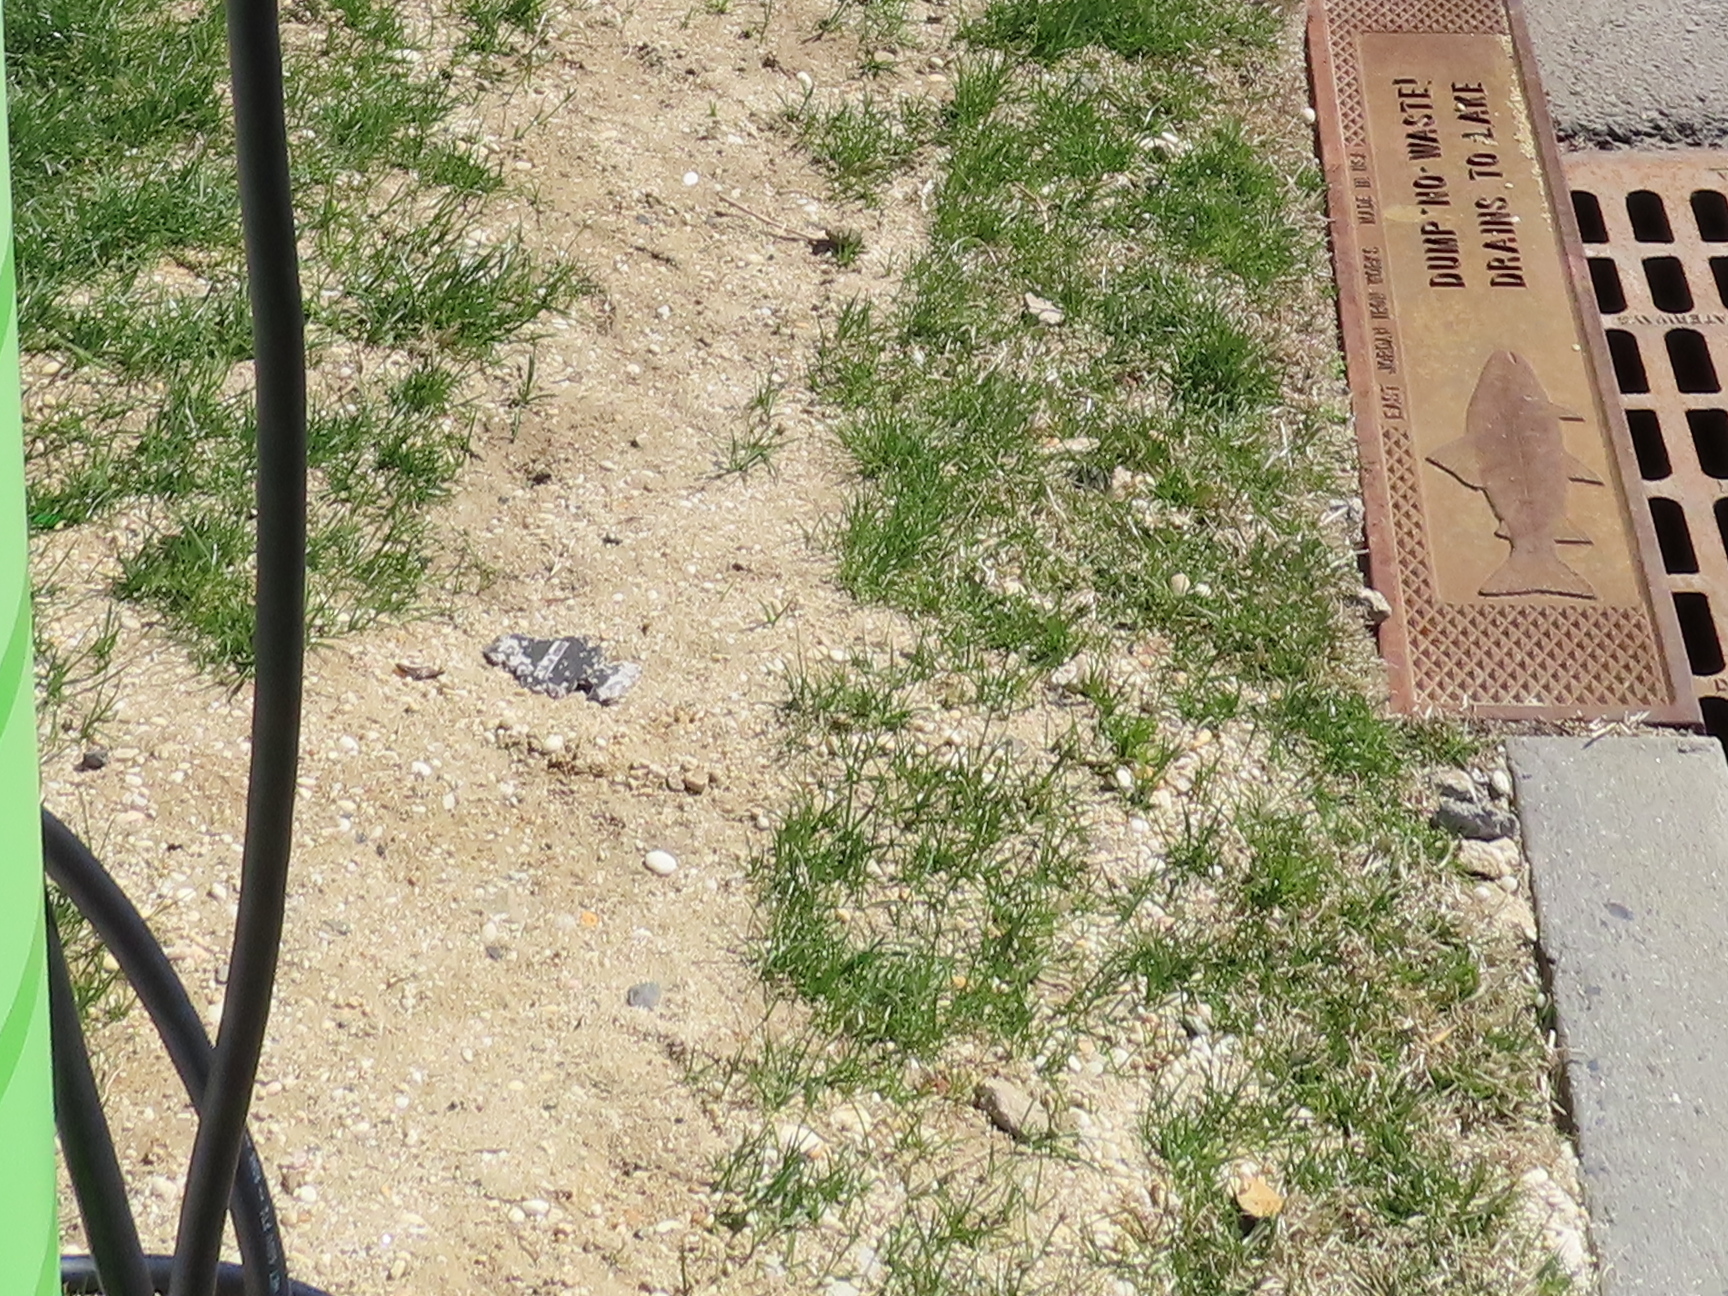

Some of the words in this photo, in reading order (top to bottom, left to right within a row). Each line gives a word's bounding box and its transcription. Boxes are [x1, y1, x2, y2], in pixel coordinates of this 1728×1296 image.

[1450, 81, 1498, 146] LAKE
[1465, 152, 1504, 181] TO
[1420, 220, 1466, 288] DUMP
[1474, 196, 1528, 288] DRAINS
